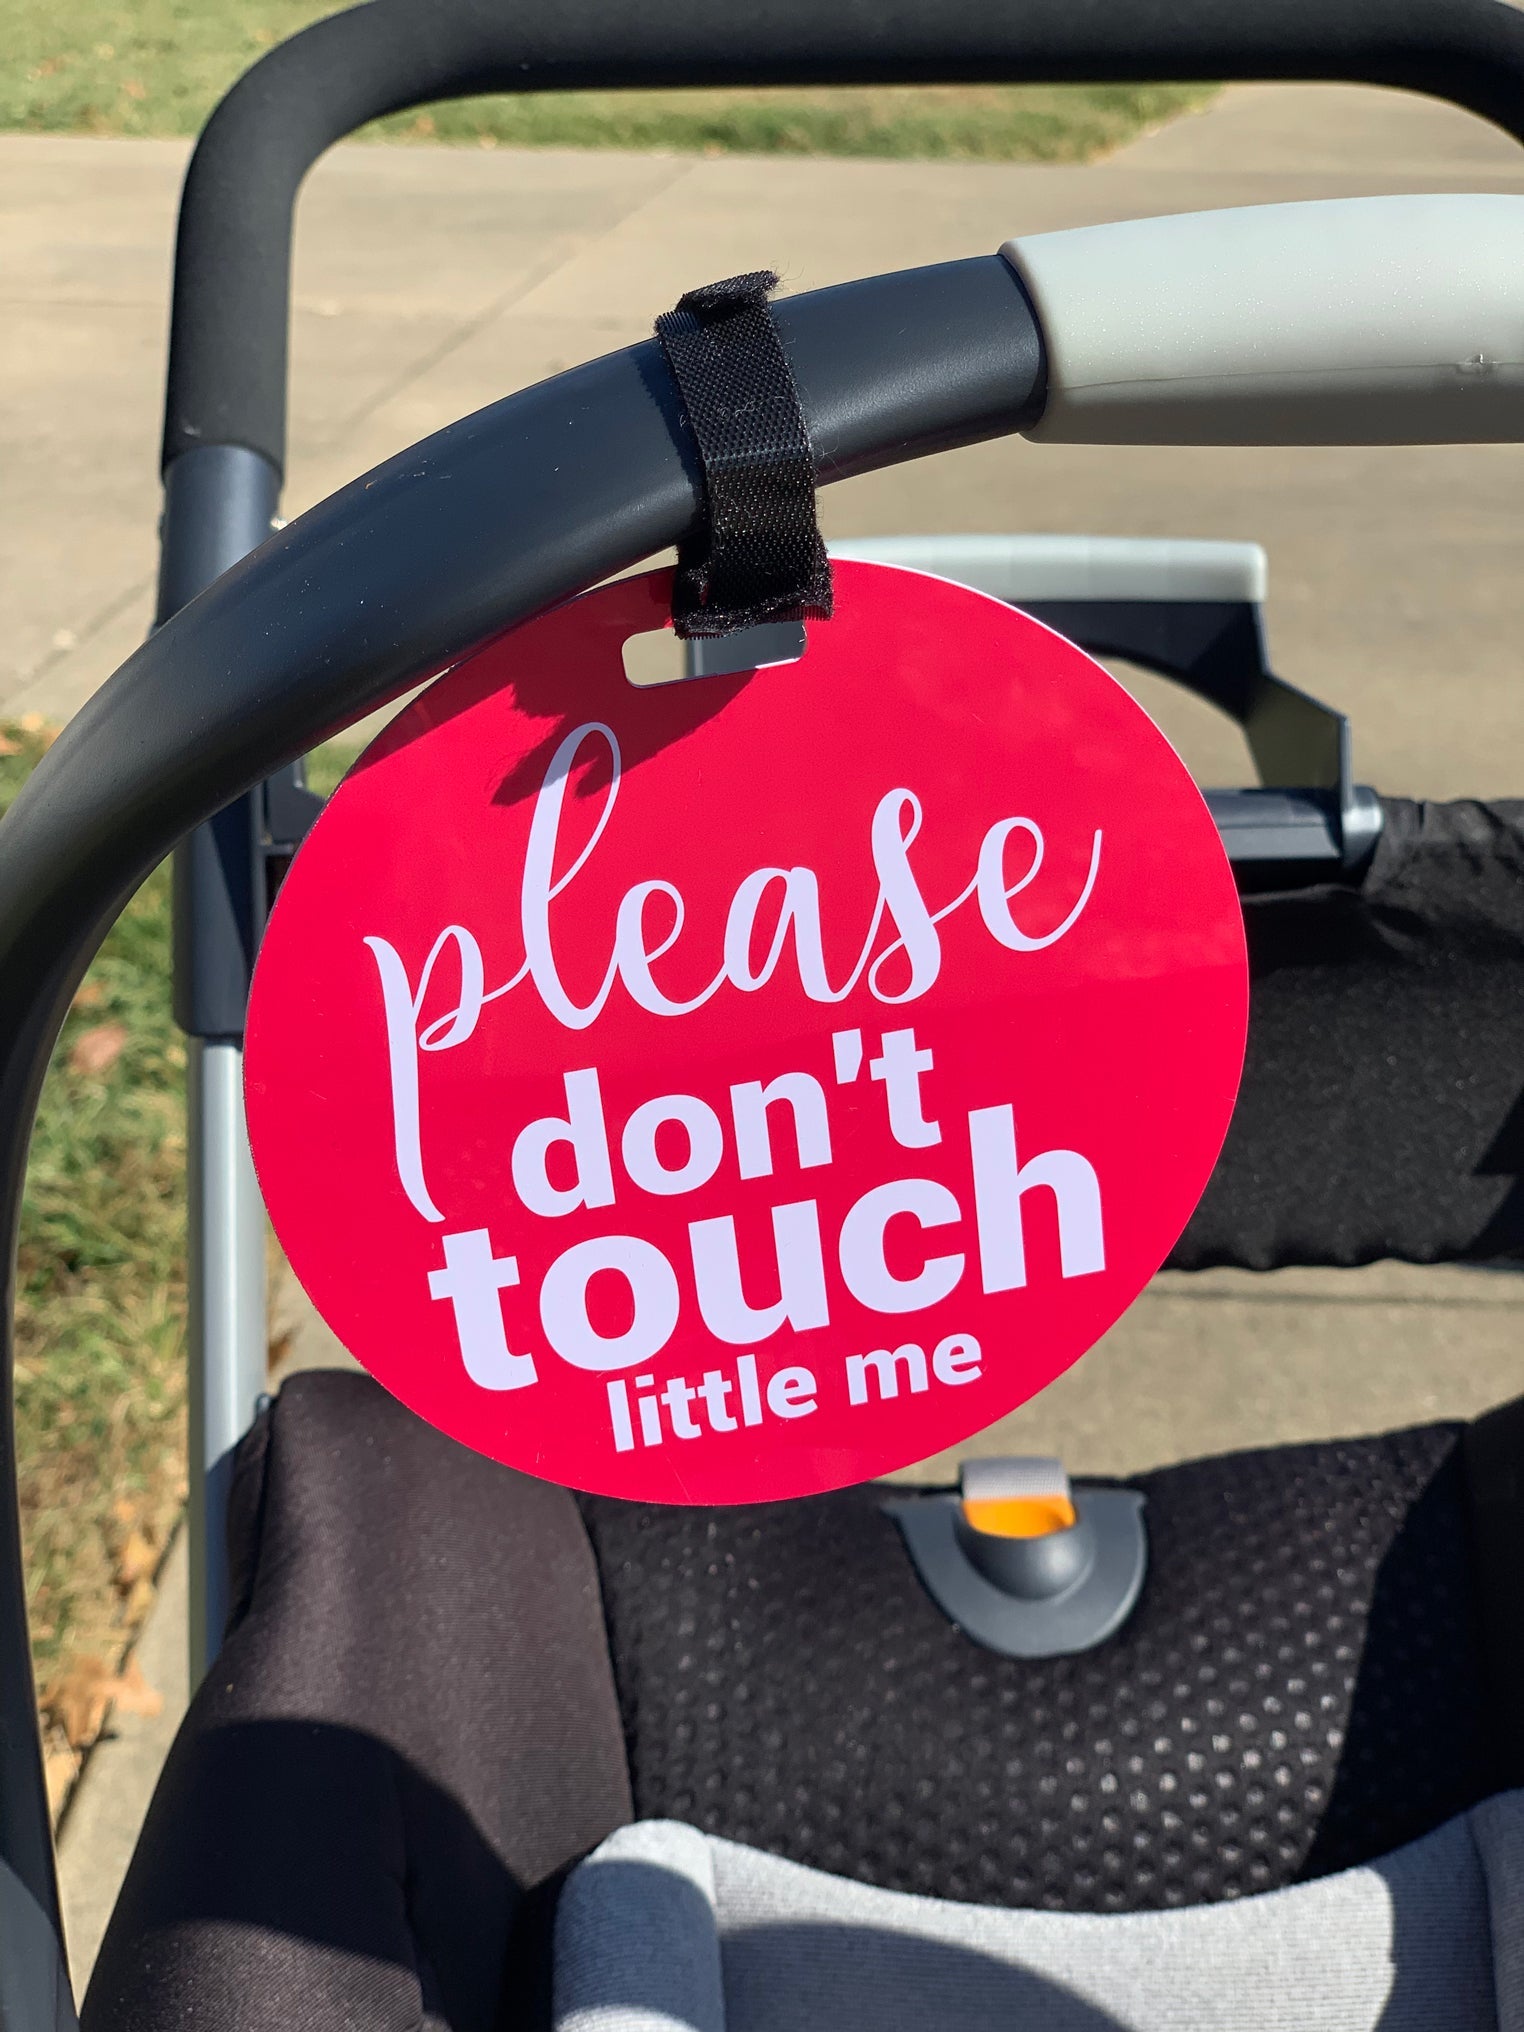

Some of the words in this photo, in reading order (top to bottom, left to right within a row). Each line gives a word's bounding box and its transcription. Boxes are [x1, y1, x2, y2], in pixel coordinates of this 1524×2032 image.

[362, 721, 1103, 1223] please
[512, 1027, 942, 1218] don't
[427, 1103, 1105, 1392] touch
[606, 1353, 819, 1453] little
[846, 1333, 983, 1406] me
